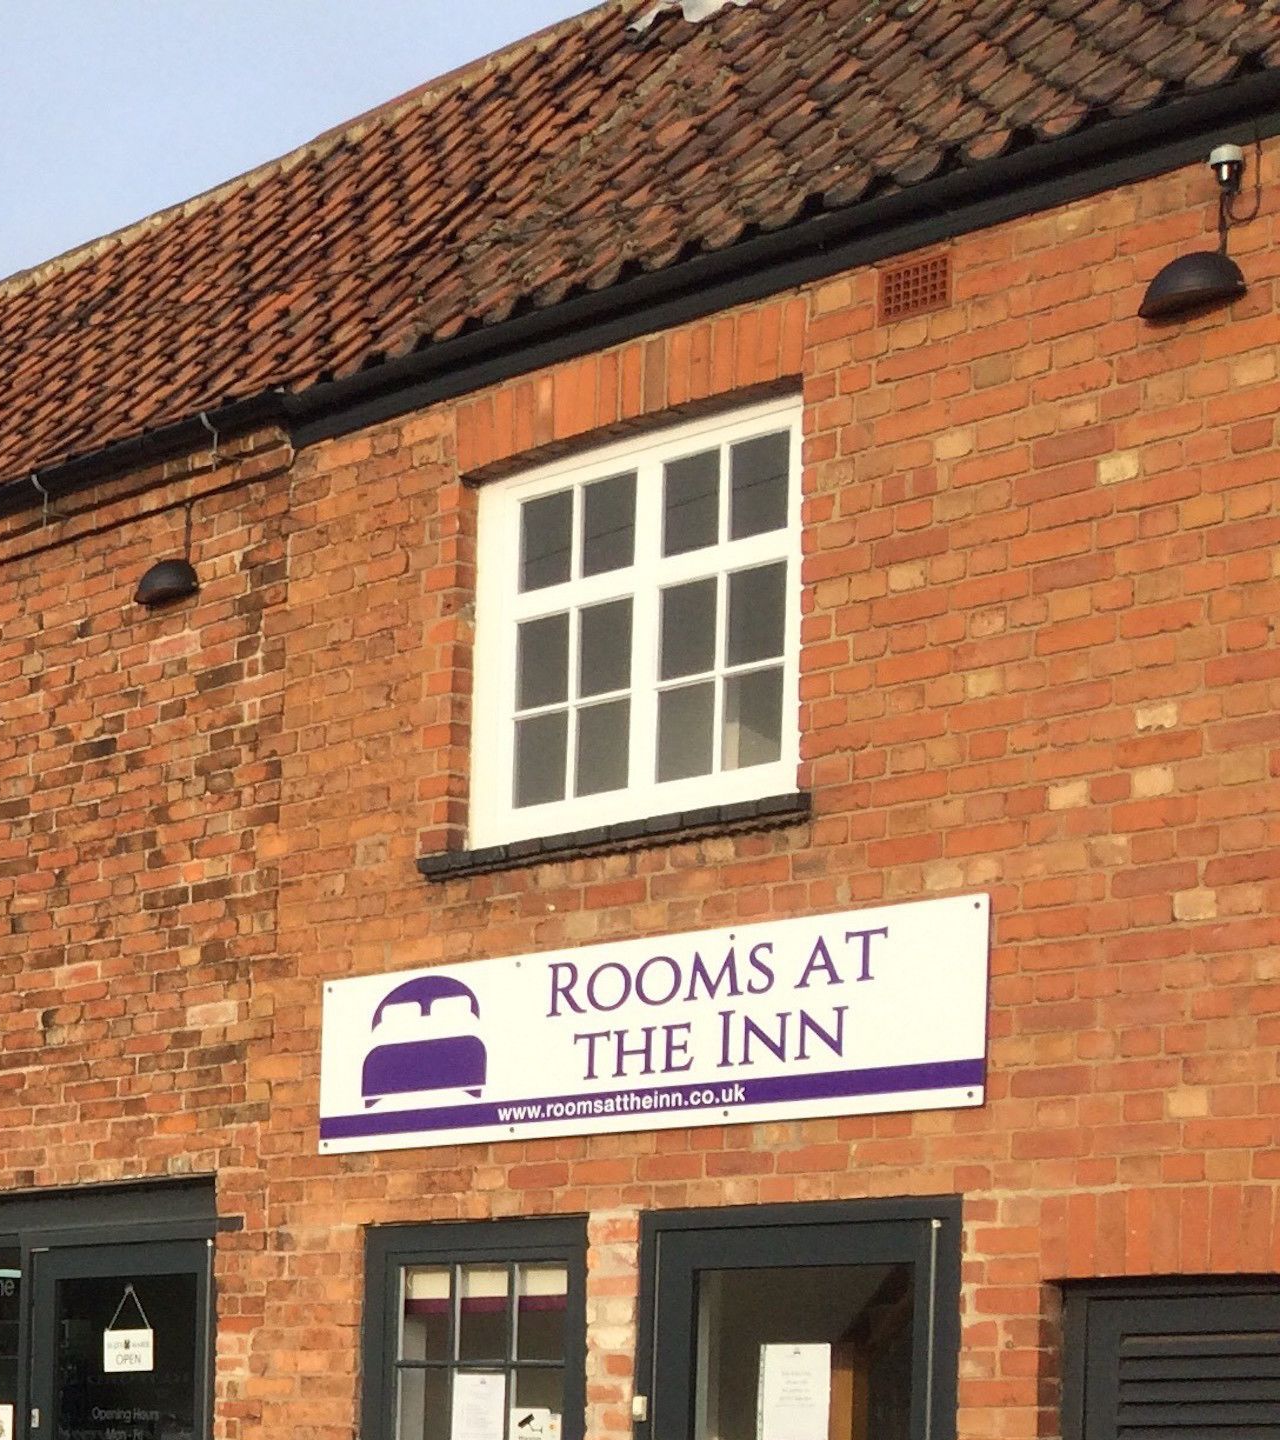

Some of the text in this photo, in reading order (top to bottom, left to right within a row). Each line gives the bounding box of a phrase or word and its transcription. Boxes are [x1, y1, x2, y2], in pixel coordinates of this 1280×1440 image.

[546, 926, 889, 1018] ROOMS AT
[573, 1005, 849, 1081] THE INN
[497, 1083, 746, 1122] www.roomsattheinn.co.uk
[115, 1353, 142, 1366] OPEN
[92, 1406, 161, 1424] Opening Hours
